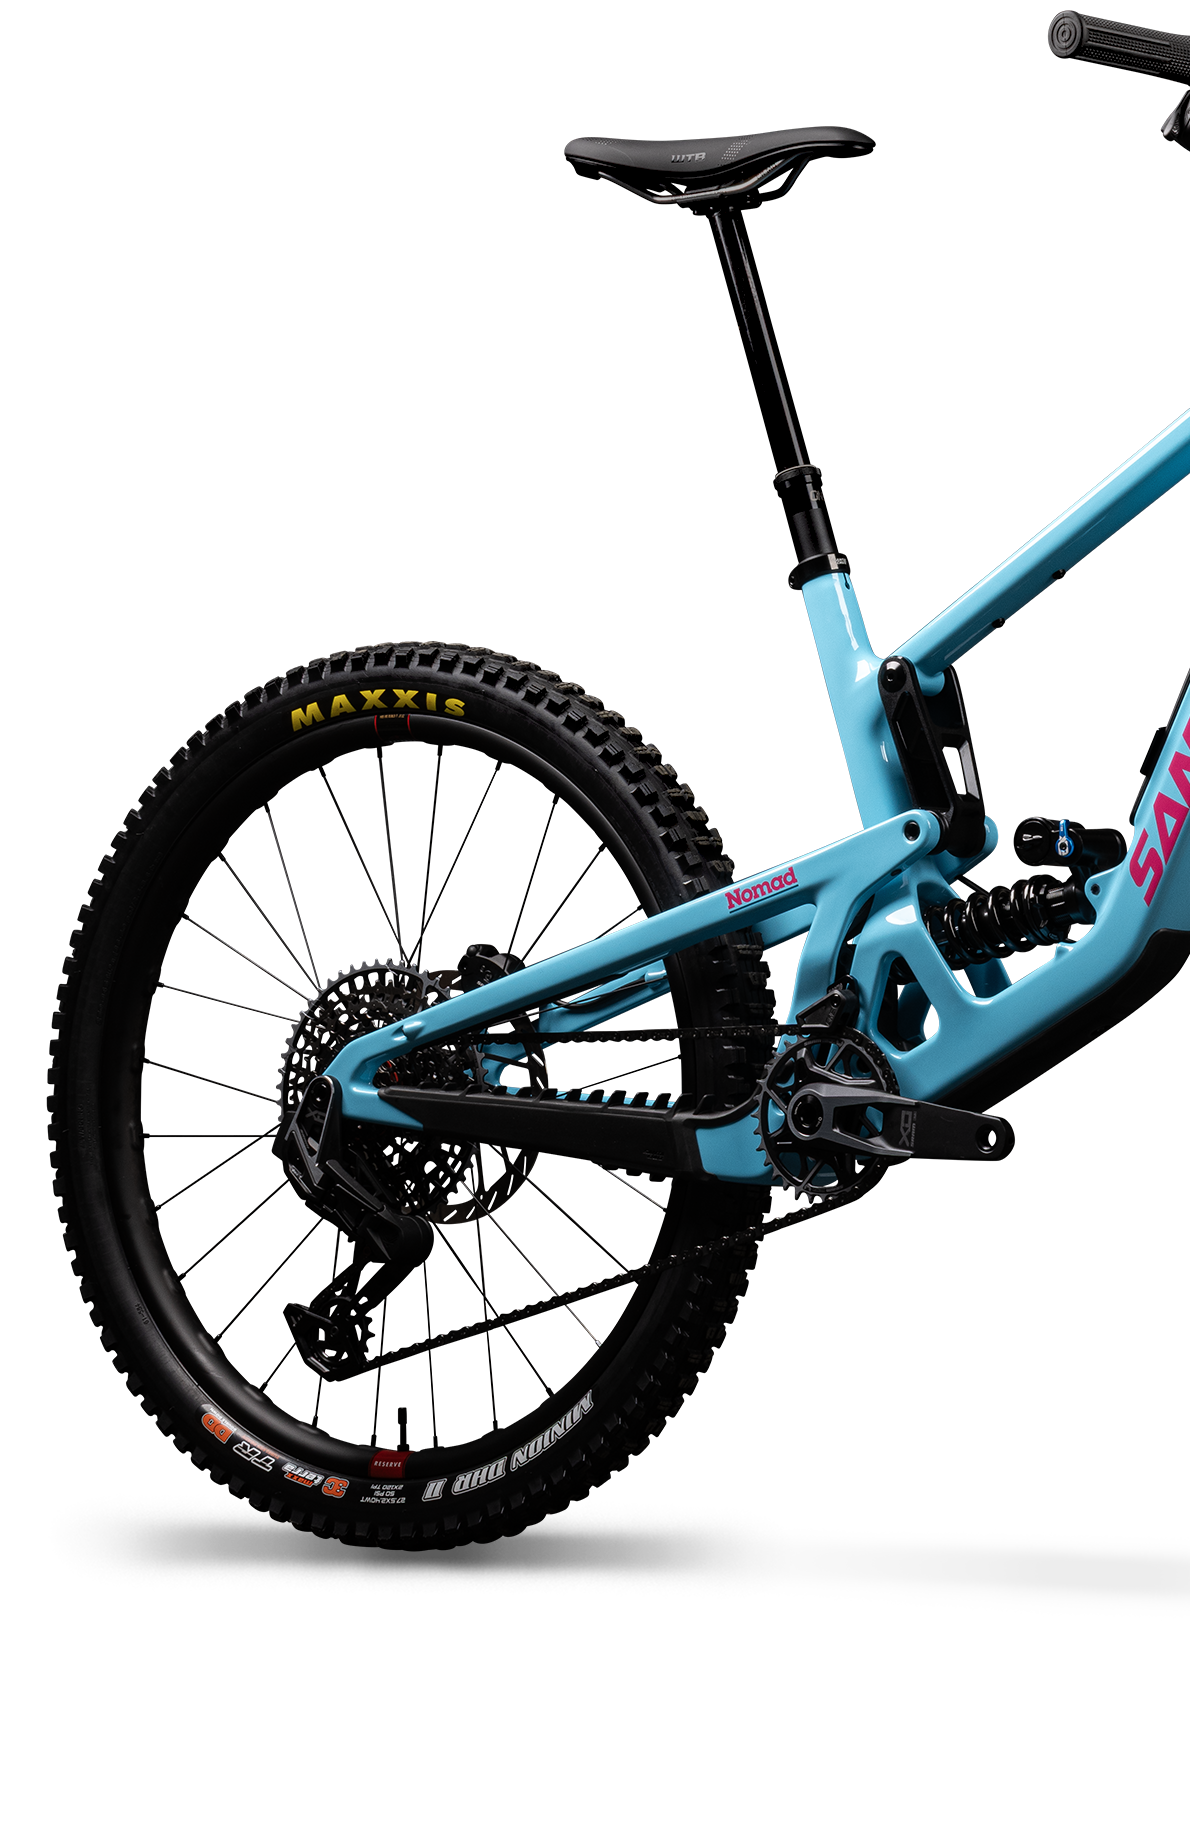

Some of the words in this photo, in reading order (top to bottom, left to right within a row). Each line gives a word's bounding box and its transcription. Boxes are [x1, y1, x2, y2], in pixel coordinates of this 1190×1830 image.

[671, 152, 707, 164] WTB
[290, 688, 466, 732] MAXXIS
[725, 867, 798, 909] Nomad
[201, 1412, 234, 1445] DD
[510, 1389, 595, 1472] MINION
[232, 1440, 276, 1473] TR
[373, 1460, 402, 1468] RESERVE
[281, 1462, 325, 1486] terra
[286, 1472, 314, 1487] maxx
[321, 1475, 351, 1499] 3C
[451, 1456, 508, 1497] DHR
